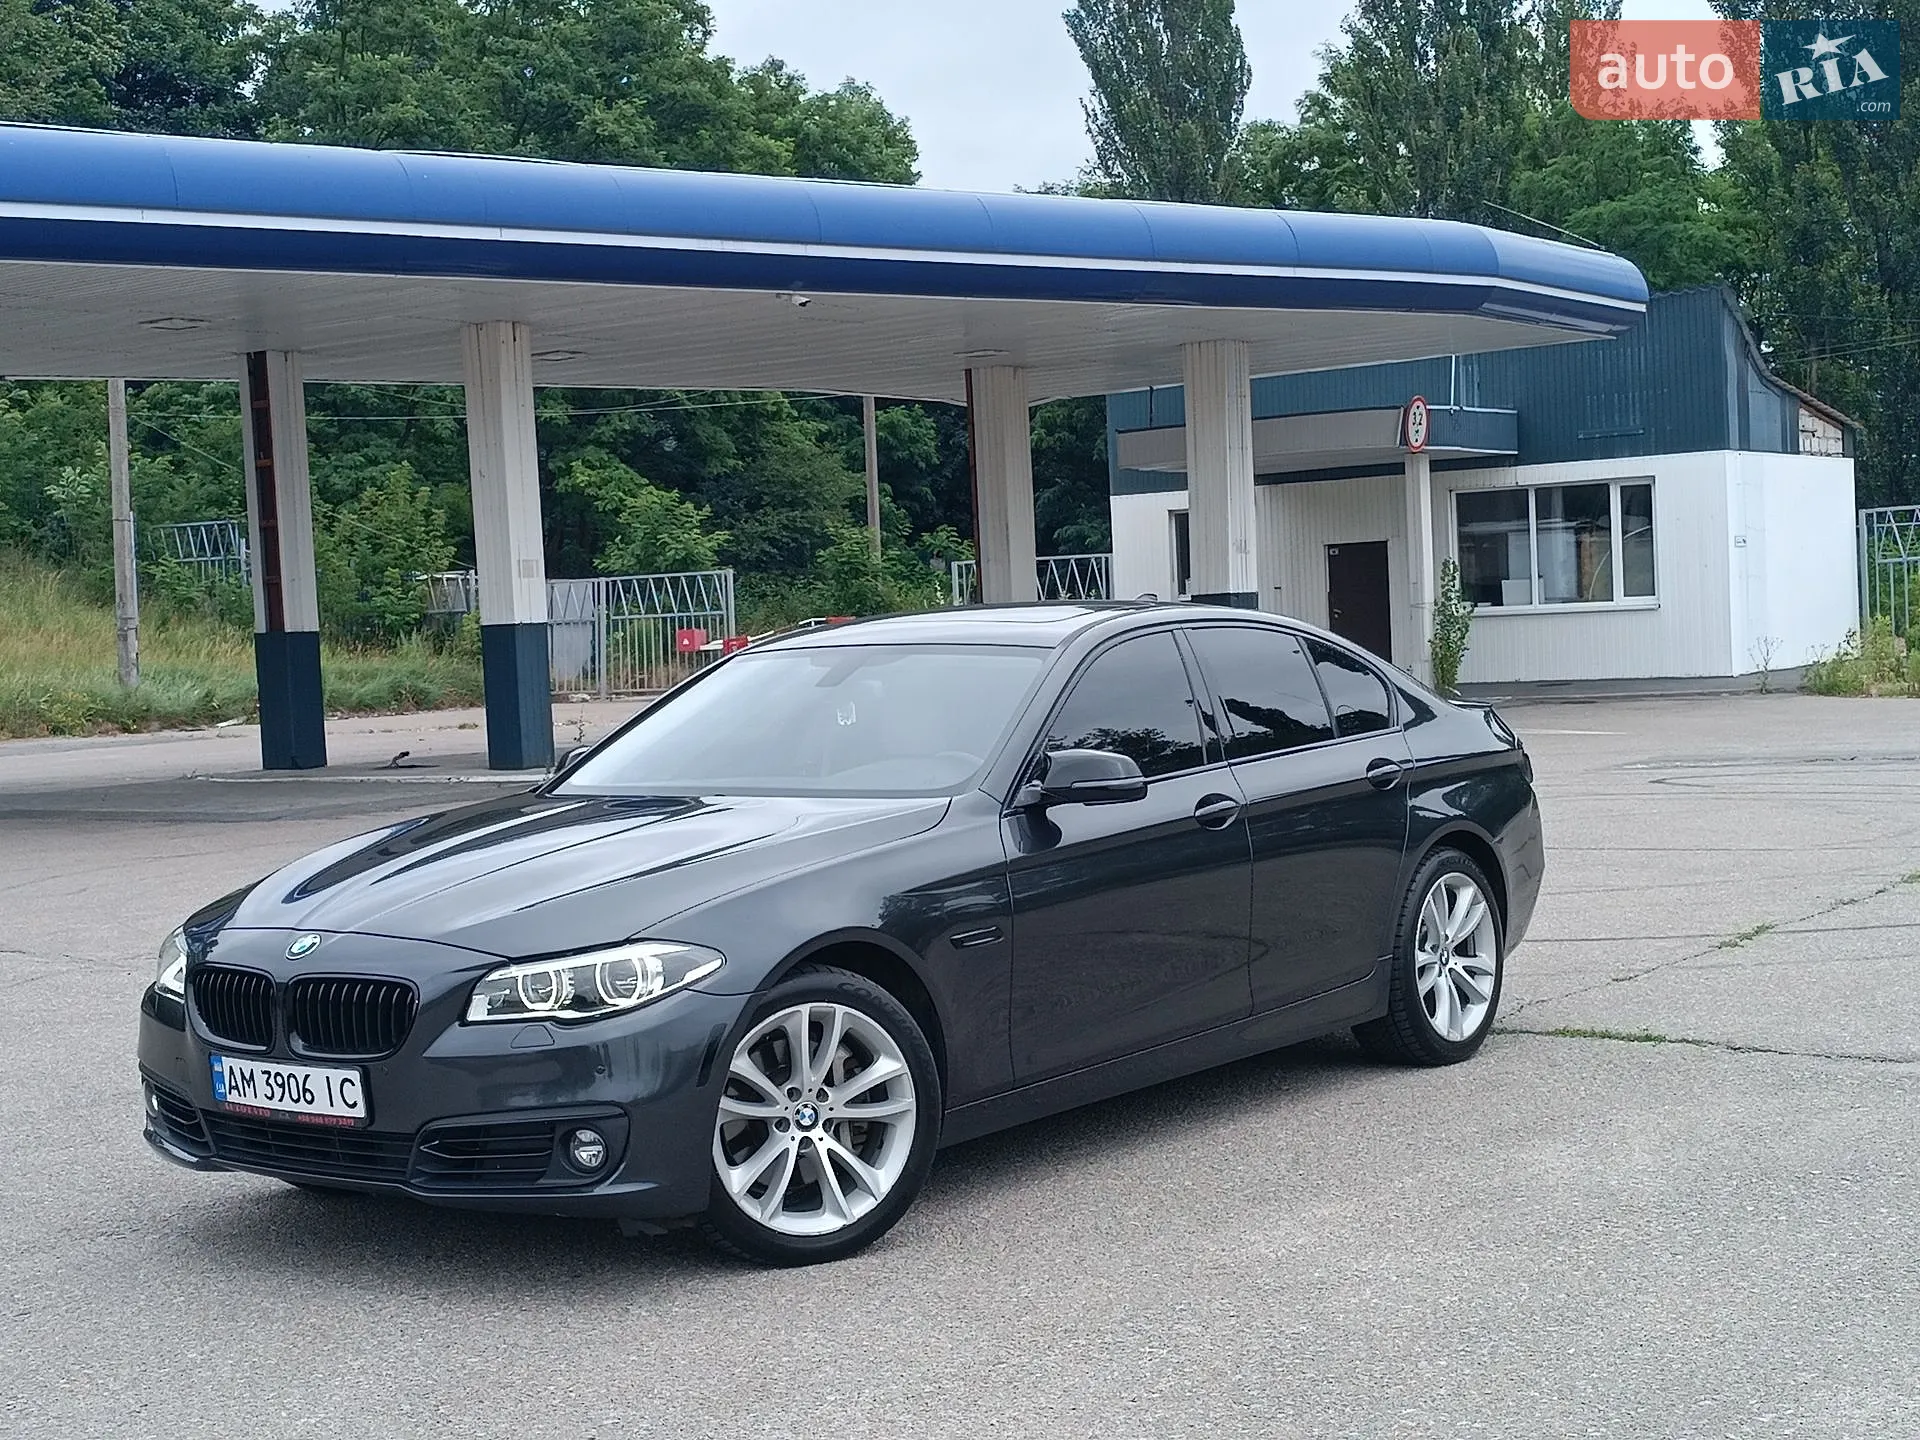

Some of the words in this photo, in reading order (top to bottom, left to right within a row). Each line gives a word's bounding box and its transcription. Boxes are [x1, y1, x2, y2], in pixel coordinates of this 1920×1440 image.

[229, 1065, 257, 1099] AM
[261, 1069, 315, 1105] 3906
[325, 1075, 358, 1109] IC
